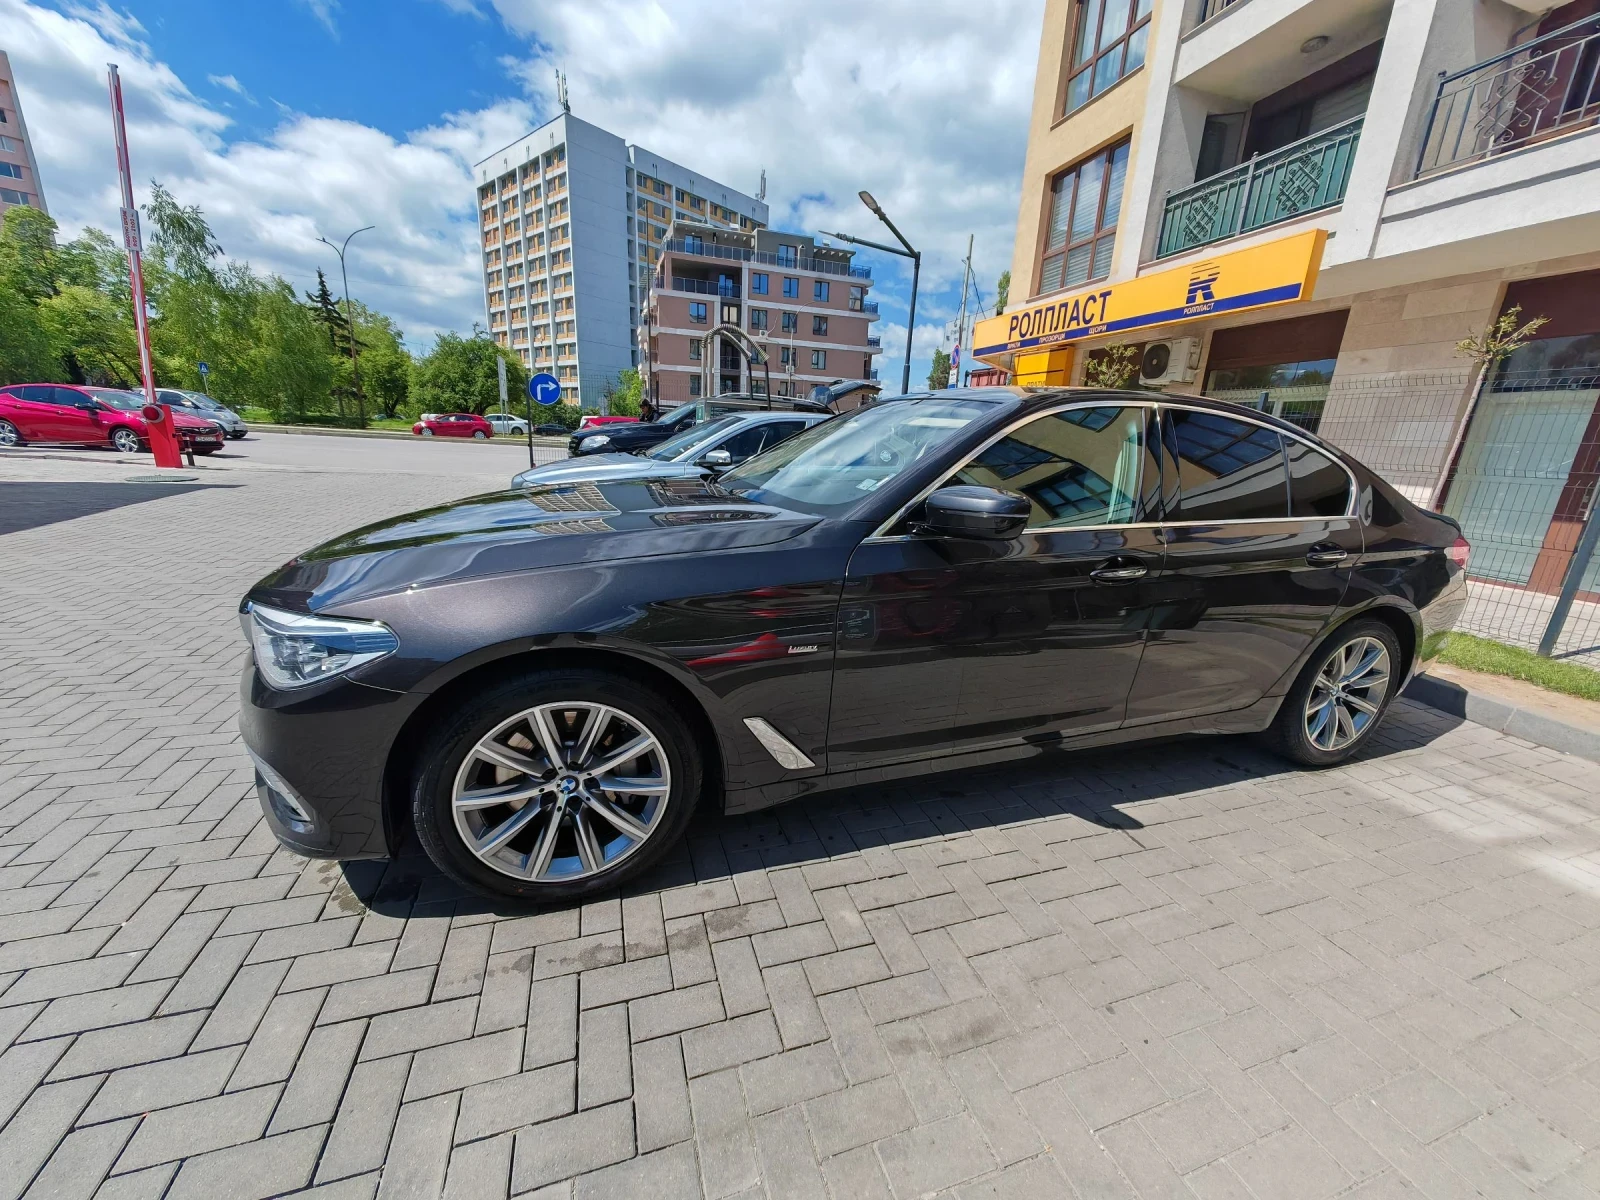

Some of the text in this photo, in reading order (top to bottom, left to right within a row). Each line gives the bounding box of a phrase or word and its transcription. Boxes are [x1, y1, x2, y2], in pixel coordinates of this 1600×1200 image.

[1008, 290, 1112, 340] РОЛПЛАСТ
[1039, 333, 1066, 344] ПРОЗОРЦИ
[1088, 324, 1107, 334] ЩОРИ
